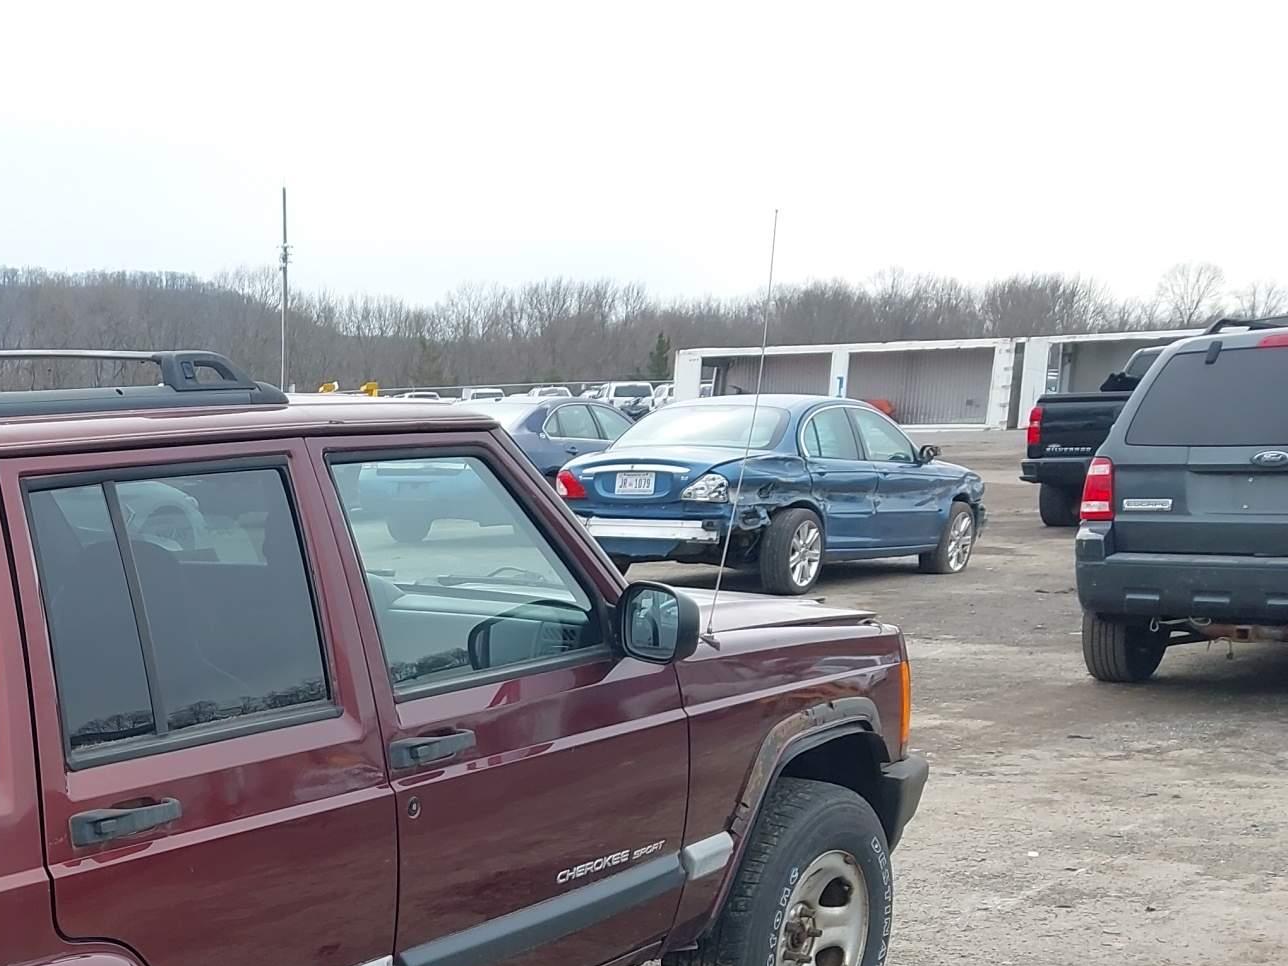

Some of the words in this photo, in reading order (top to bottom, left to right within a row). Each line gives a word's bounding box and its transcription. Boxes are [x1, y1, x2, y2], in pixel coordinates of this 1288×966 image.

[634, 478, 651, 489] 1079
[556, 849, 631, 884] CHEROKEE
[631, 839, 666, 860] SPORT
